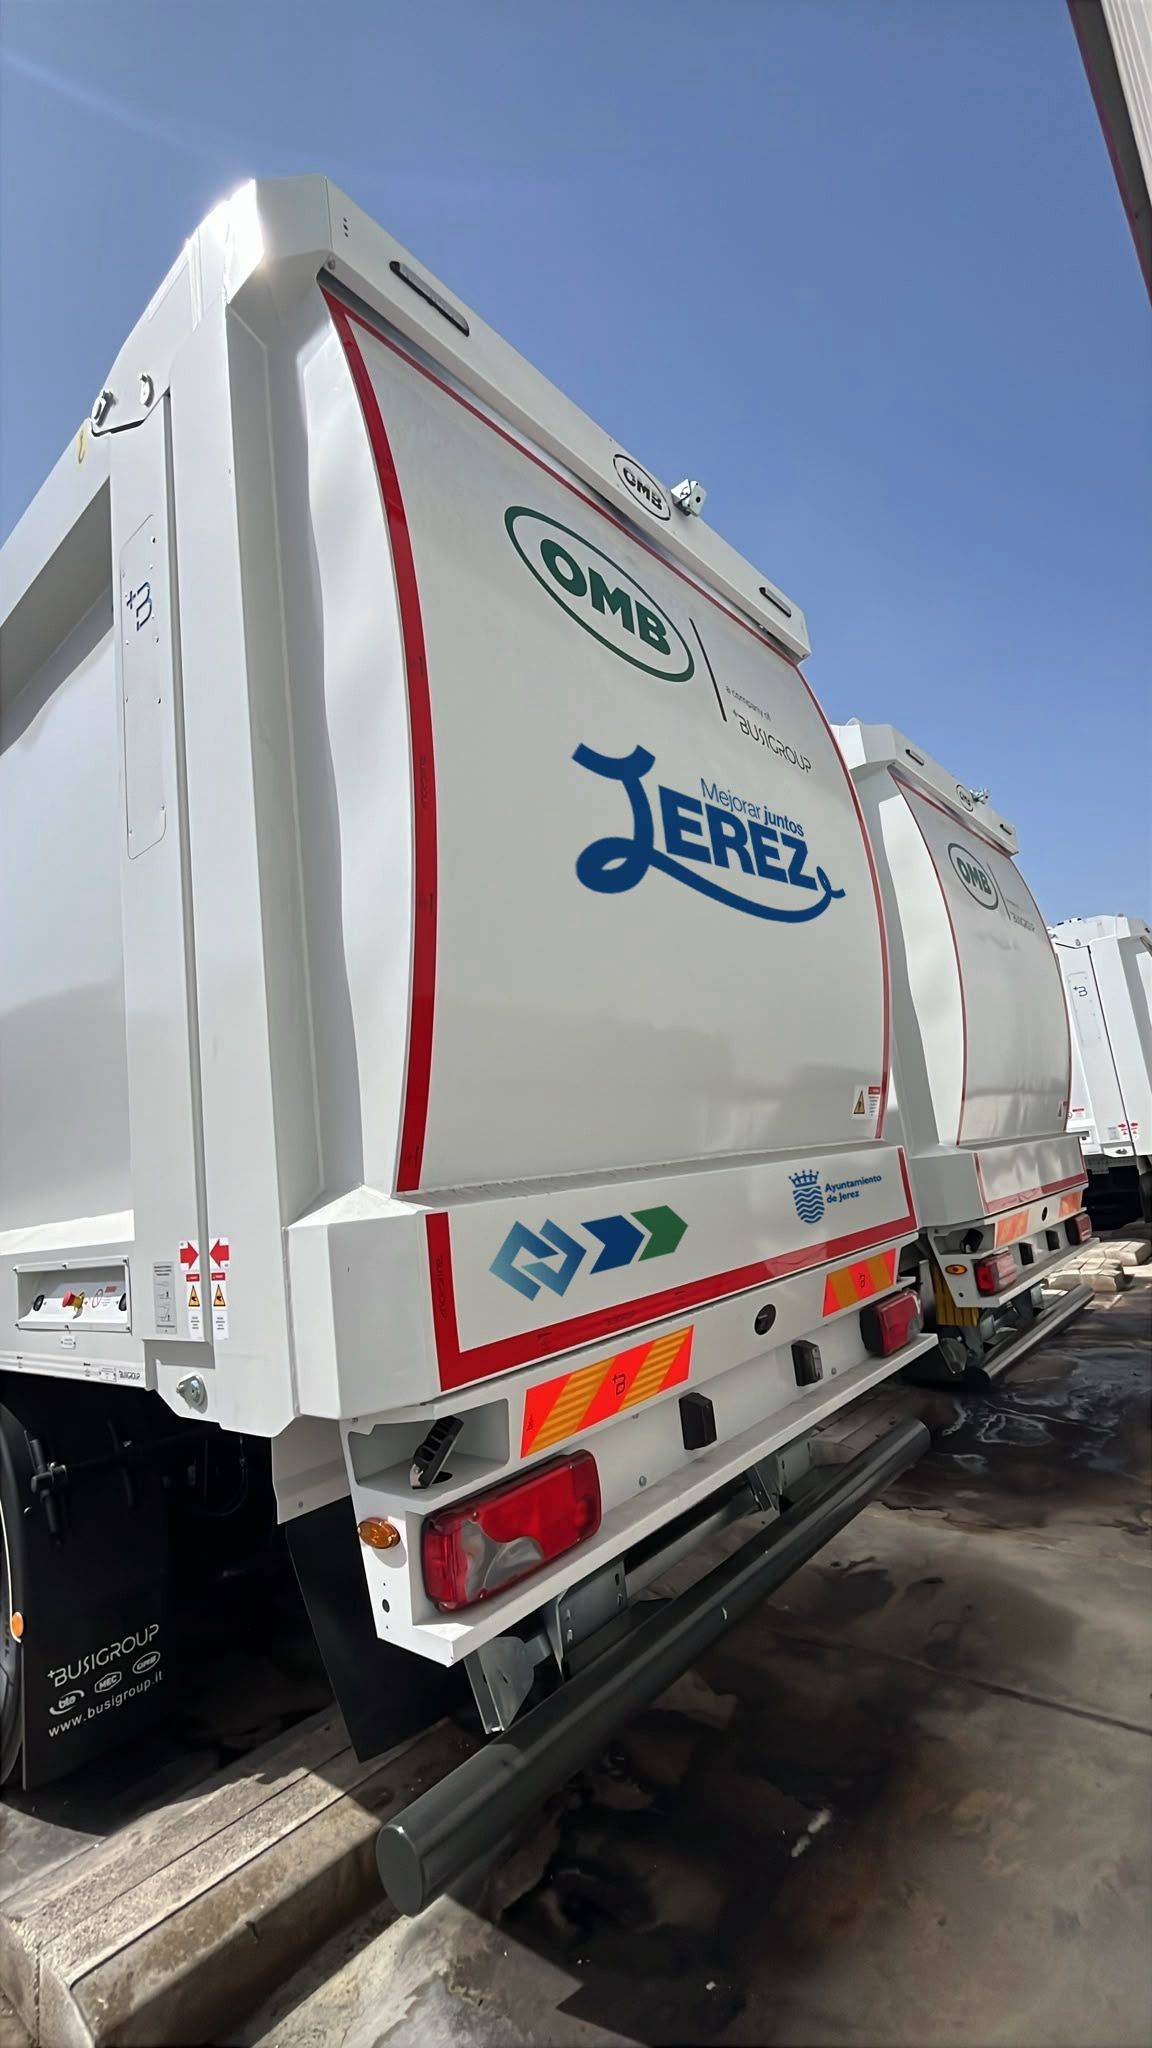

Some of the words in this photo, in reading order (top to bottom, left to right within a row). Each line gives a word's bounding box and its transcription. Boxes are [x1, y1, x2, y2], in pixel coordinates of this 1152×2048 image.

[540, 538, 671, 656] OMB
[700, 777, 761, 820] Mejorar
[764, 805, 805, 837] juntos
[571, 742, 847, 924] JEREZ
[956, 857, 992, 895] OMB
[824, 1174, 882, 1193] Ayuntamiento
[826, 1194, 838, 1203] de
[839, 1190, 860, 1203] Jerez
[48, 1670, 163, 1737] www.busigroup.it
[99, 1674, 118, 1690] MEC
